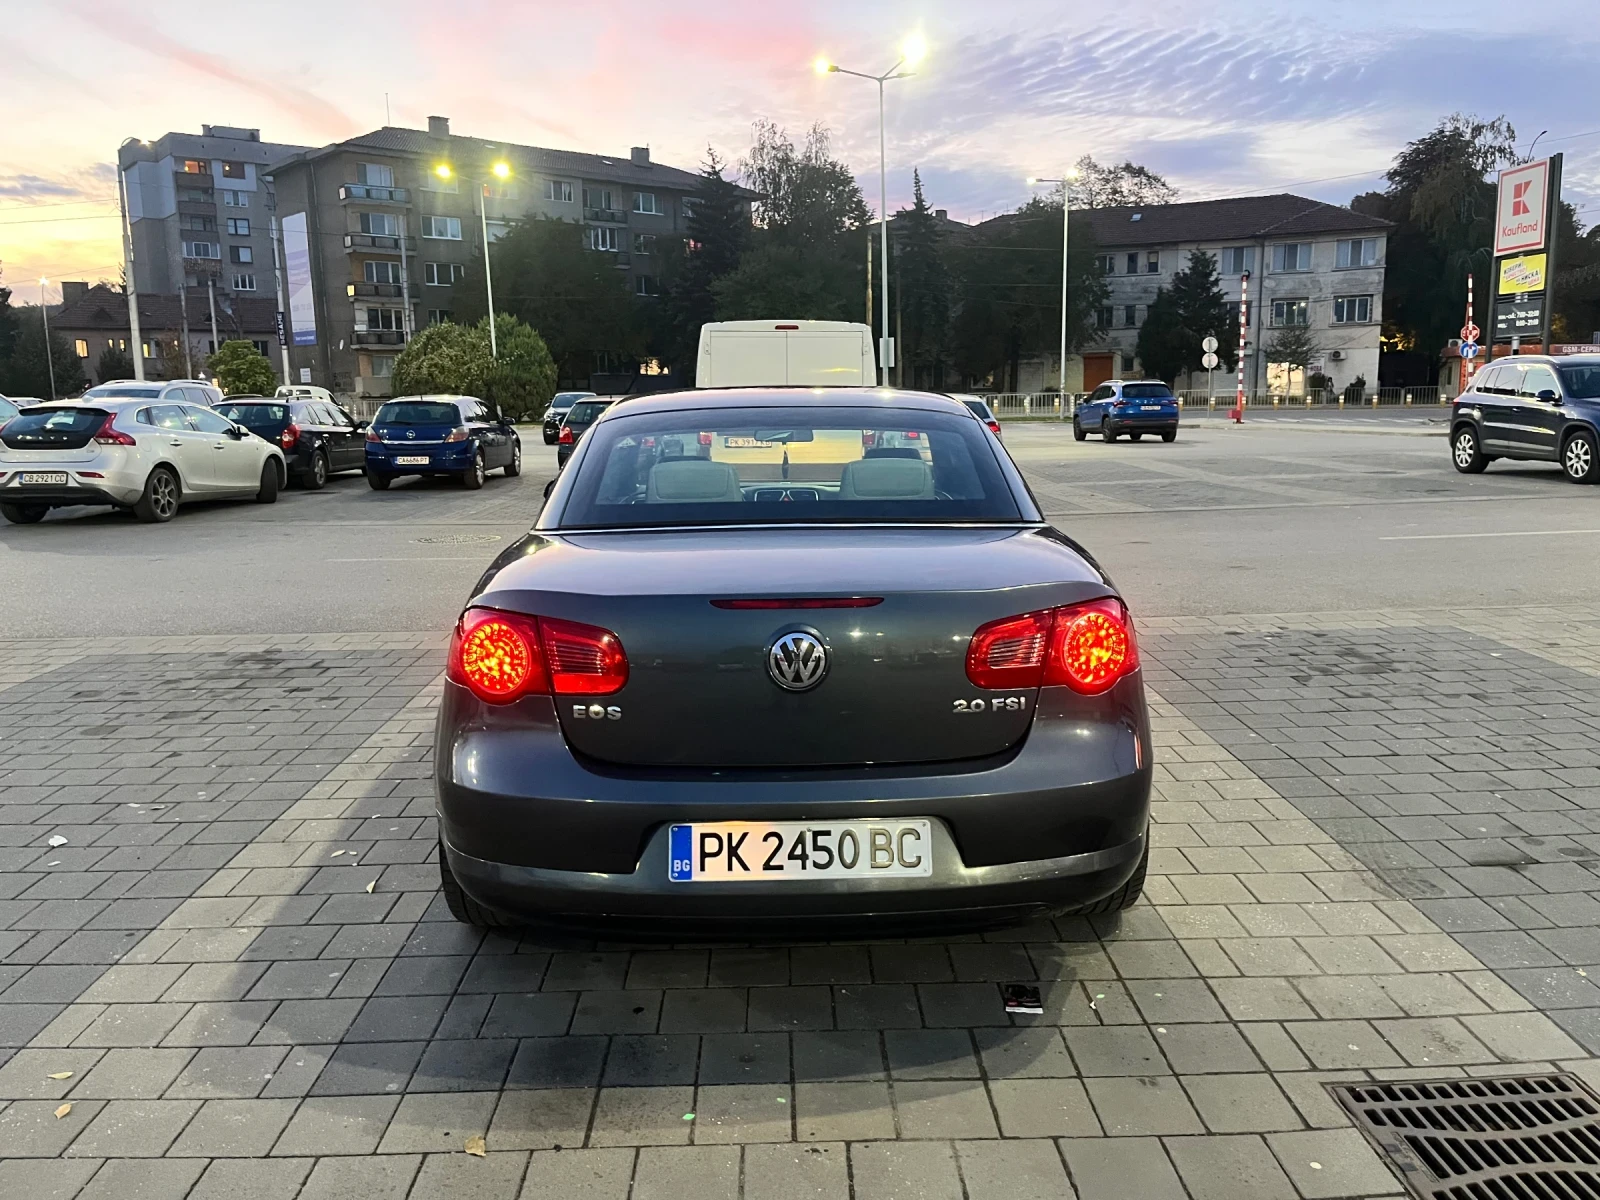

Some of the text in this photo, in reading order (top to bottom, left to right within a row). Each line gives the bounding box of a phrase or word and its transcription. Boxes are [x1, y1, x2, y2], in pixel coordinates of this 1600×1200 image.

[1502, 220, 1538, 237] Kaufland
[573, 705, 622, 720] EOS
[992, 697, 1026, 712] FSI
[673, 828, 922, 872] BG PK 2450 BC
